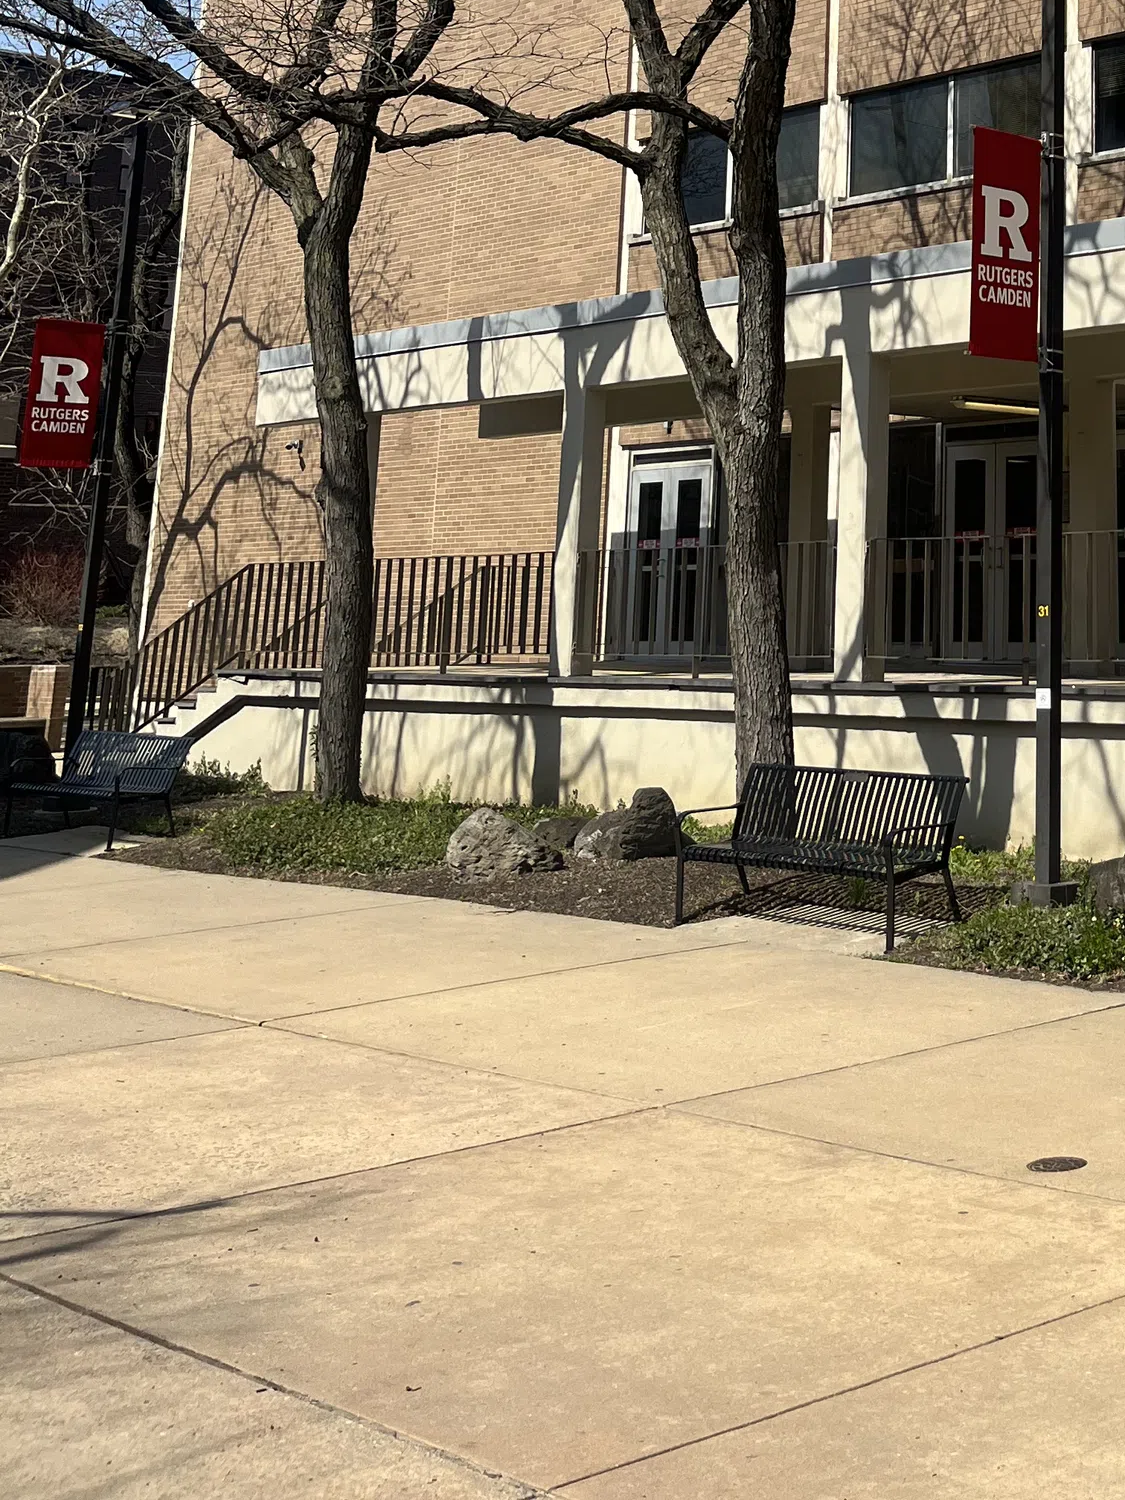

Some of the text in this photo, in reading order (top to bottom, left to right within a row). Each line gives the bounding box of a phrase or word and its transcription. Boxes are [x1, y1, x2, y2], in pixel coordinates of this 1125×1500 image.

[981, 184, 1032, 262] R
[978, 263, 1033, 288] RUTGERS
[978, 284, 1031, 308] CAMDEN
[36, 355, 89, 404] R
[31, 406, 89, 421] RUTGERS
[31, 420, 86, 434] CAMDEN
[1038, 605, 1049, 617] 31
